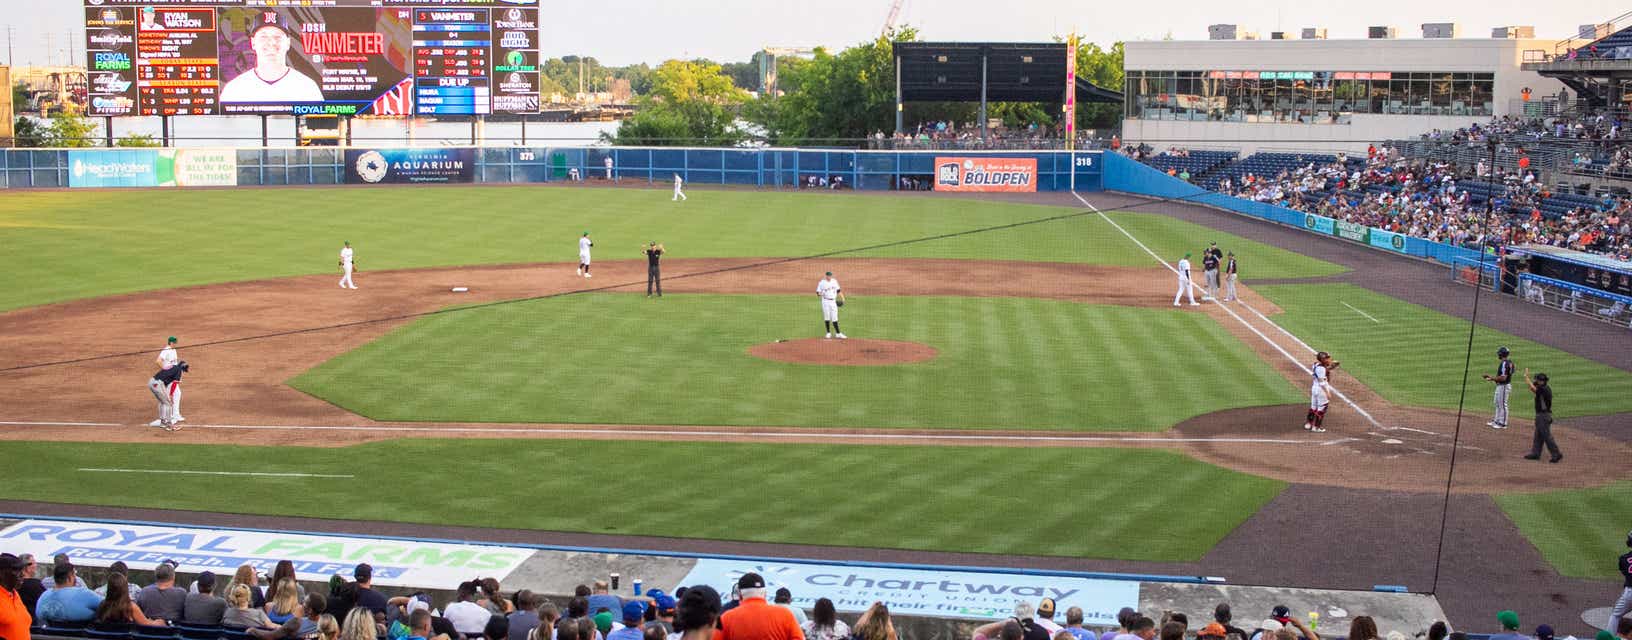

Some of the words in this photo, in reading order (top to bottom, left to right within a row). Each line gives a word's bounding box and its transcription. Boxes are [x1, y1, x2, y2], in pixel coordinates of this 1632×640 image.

[431, 12, 475, 21] VANMETER
[302, 23, 326, 32] JOSH
[91, 36, 132, 45] Smithfield
[505, 32, 526, 40] BUD
[302, 32, 384, 54] VANMETER
[501, 39, 529, 47] LIGHT
[96, 53, 130, 61] ROYAL
[96, 61, 131, 70] FARMS
[520, 153, 534, 161] 375
[393, 161, 463, 169] AQUARIUM
[1076, 158, 1091, 166] 318
[964, 172, 1030, 185] BOLDPEN
[1, 524, 238, 552] ROYAL
[254, 539, 518, 569] FARMS
[66, 548, 129, 560] Real
[140, 552, 226, 567] Fresh.
[242, 559, 311, 571] Rel
[805, 574, 1080, 600] Chartway
[839, 590, 927, 599] CREDIT
[945, 595, 1026, 604] UNION
